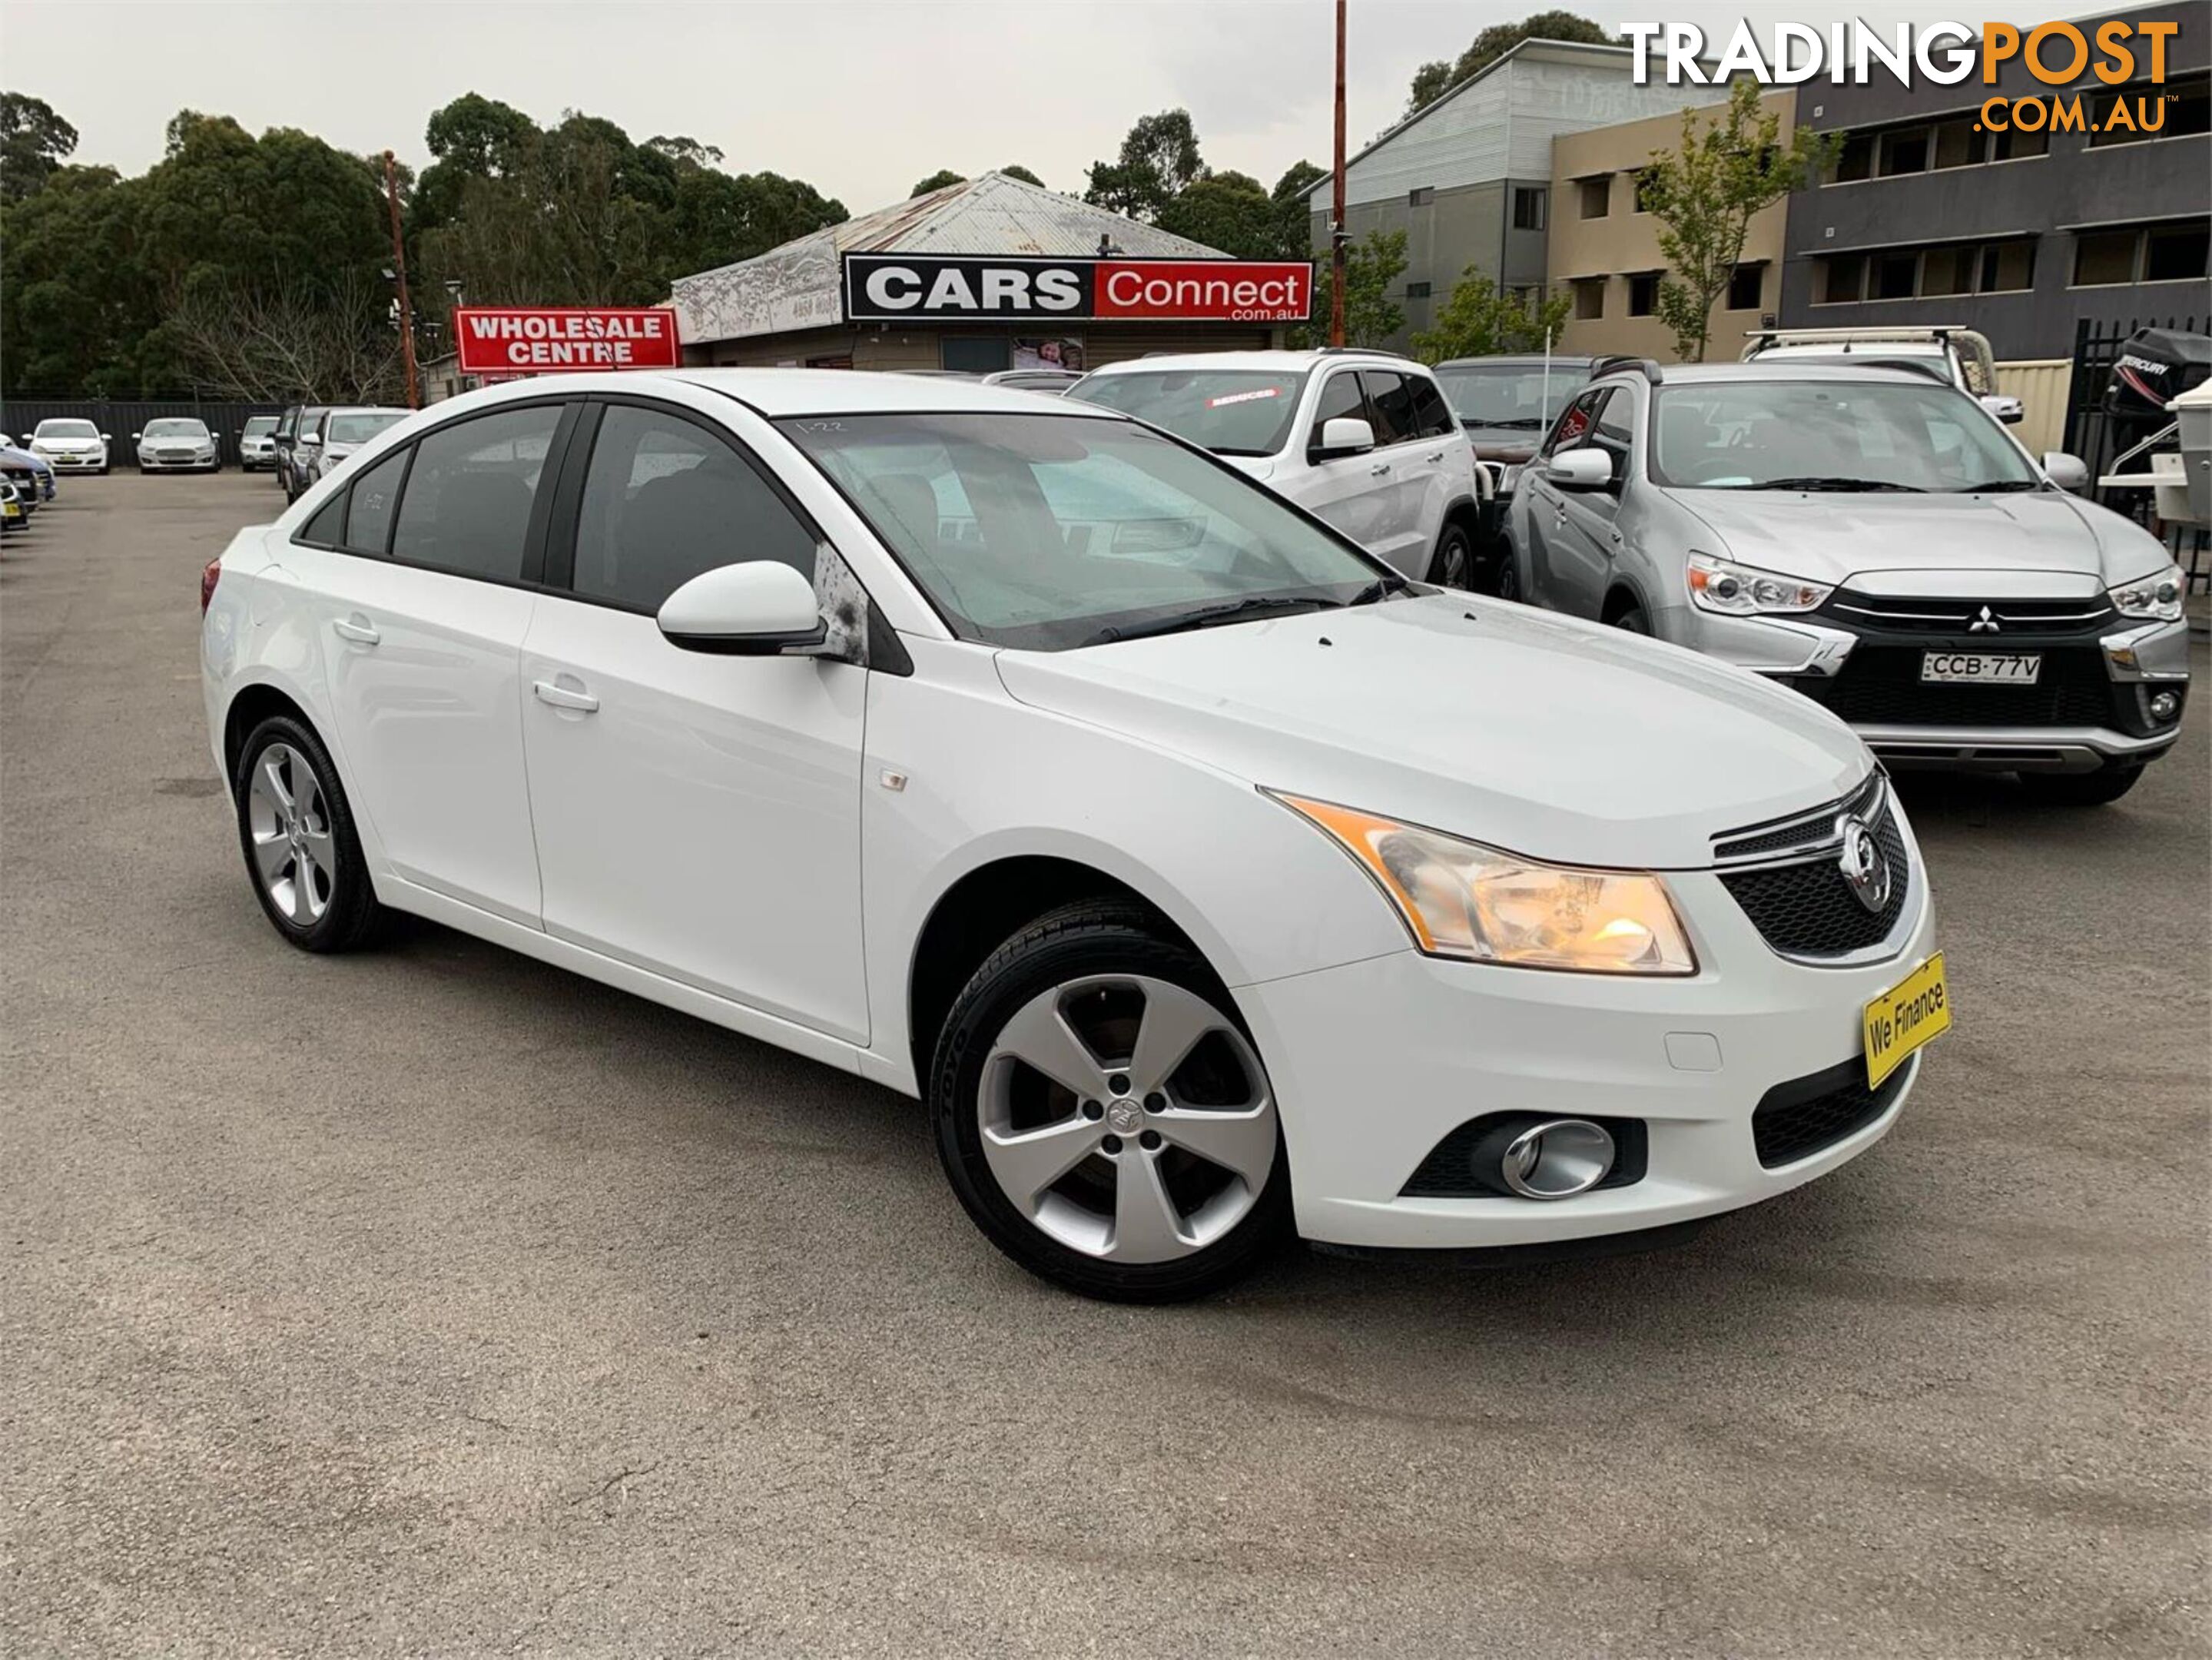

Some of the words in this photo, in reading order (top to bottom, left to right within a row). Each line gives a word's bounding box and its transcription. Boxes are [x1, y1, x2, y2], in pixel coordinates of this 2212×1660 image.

[866, 266, 1081, 310] CARS
[1107, 271, 1299, 307] Connect
[469, 316, 662, 339] WHOLESALE
[507, 342, 633, 364] CENTRE
[1869, 1015, 1892, 1058] We
[1894, 981, 1945, 1041] Finance
